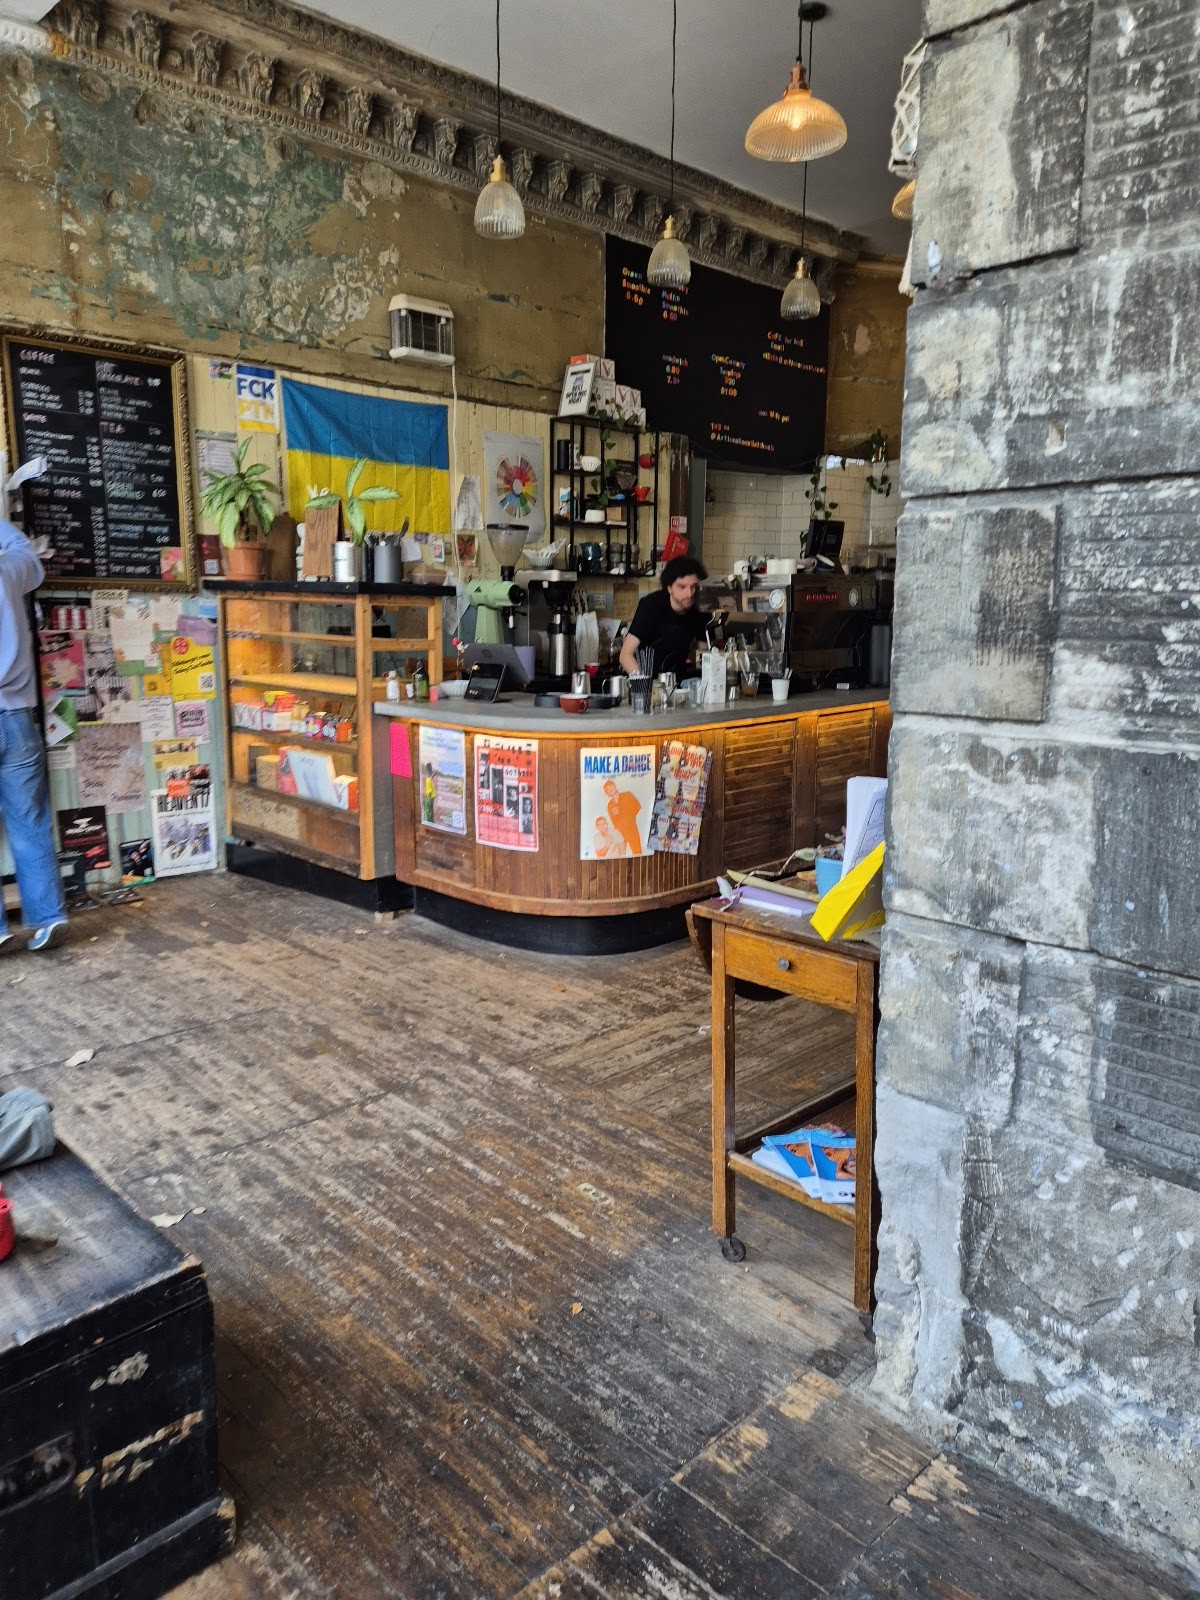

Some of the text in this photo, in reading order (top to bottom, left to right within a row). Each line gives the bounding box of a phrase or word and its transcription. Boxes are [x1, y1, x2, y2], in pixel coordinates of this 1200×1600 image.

[622, 267, 643, 280] Green
[236, 377, 275, 401] FCK
[584, 755, 611, 774] MAKE
[614, 755, 620, 773] A
